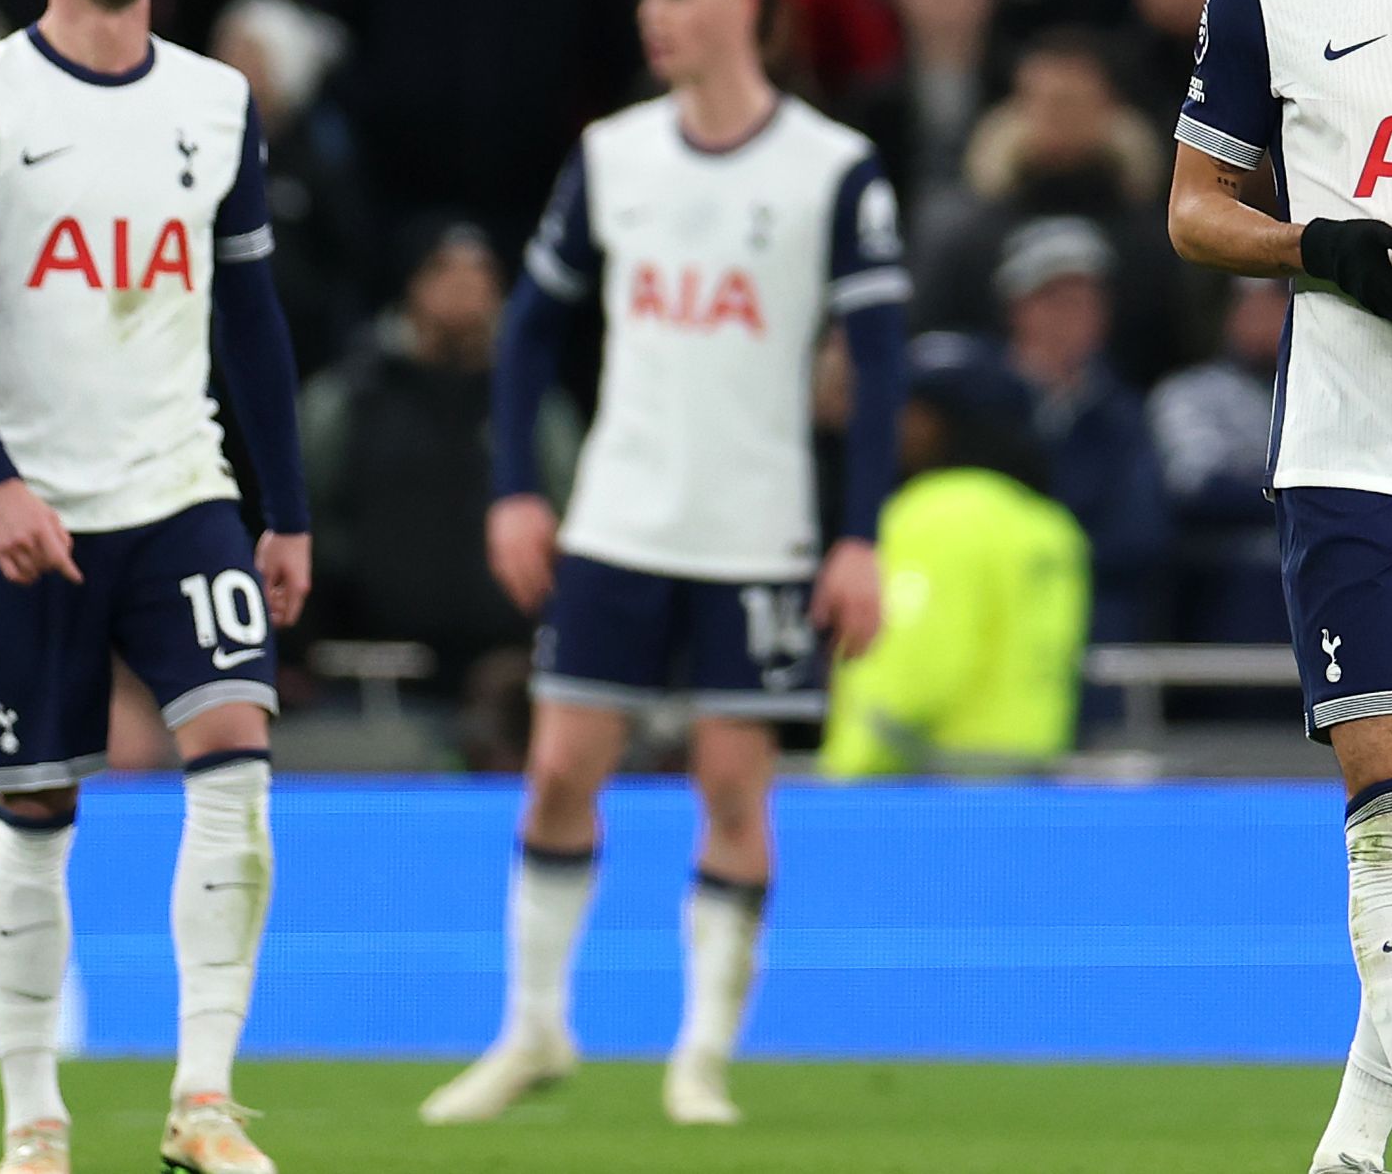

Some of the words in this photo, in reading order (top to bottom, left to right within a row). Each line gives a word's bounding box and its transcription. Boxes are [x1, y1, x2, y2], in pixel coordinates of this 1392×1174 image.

[24, 214, 196, 294] AIA
[629, 260, 770, 342] AIA
[177, 567, 268, 649] 10
